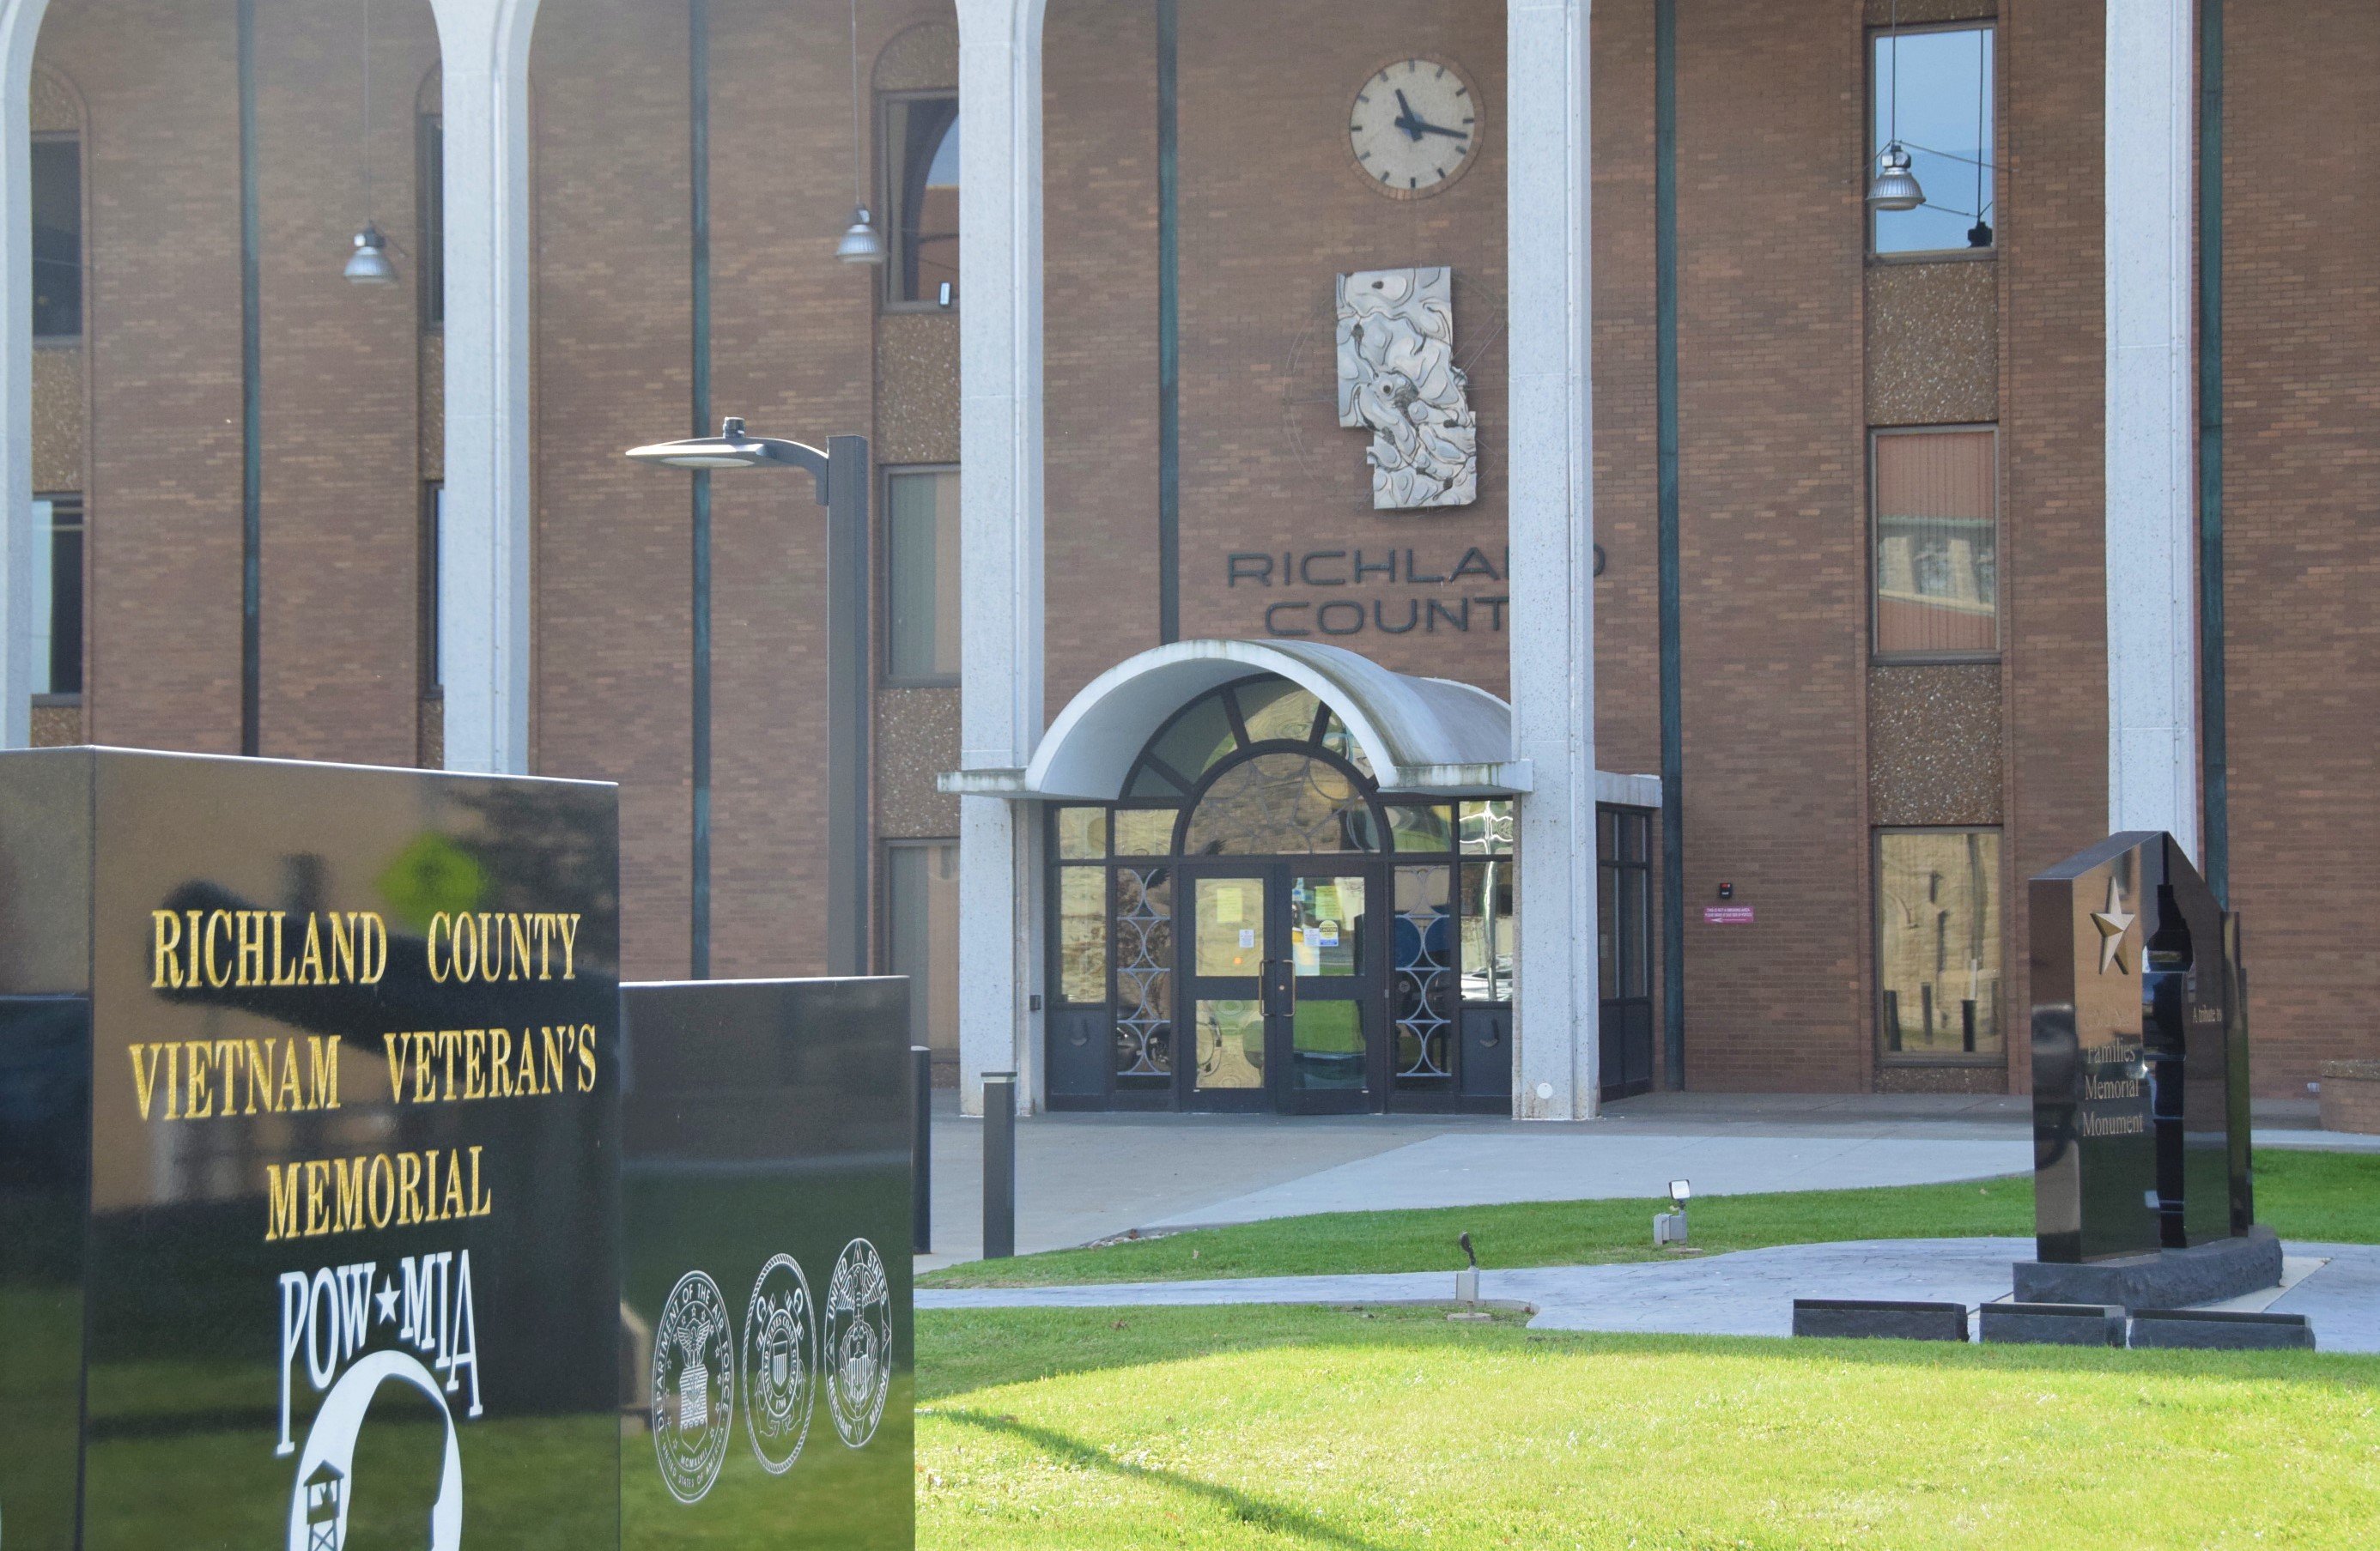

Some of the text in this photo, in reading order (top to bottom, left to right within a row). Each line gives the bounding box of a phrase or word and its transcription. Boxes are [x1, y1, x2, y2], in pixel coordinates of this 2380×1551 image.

[1228, 543, 1606, 587] RICHLA
[1266, 595, 1510, 636] COUNT
[150, 908, 581, 989] RICHLAND COUNTY
[128, 1024, 596, 1120] VIETNAM VETERAN'S
[2087, 1037, 2135, 1063] Families
[2085, 1075, 2140, 1100] Memorial
[2083, 1112, 2144, 1136] Monument
[265, 1146, 490, 1240] MEMORIAL
[829, 1250, 887, 1319] UNITED STATES
[276, 1249, 483, 1455] POW MIA
[656, 1300, 679, 1432] DEPARTMENT
[683, 1283, 693, 1303] OF
[697, 1283, 711, 1305] THE
[712, 1303, 725, 1332] AIR
[828, 1366, 888, 1439] MERCHANT MARINE
